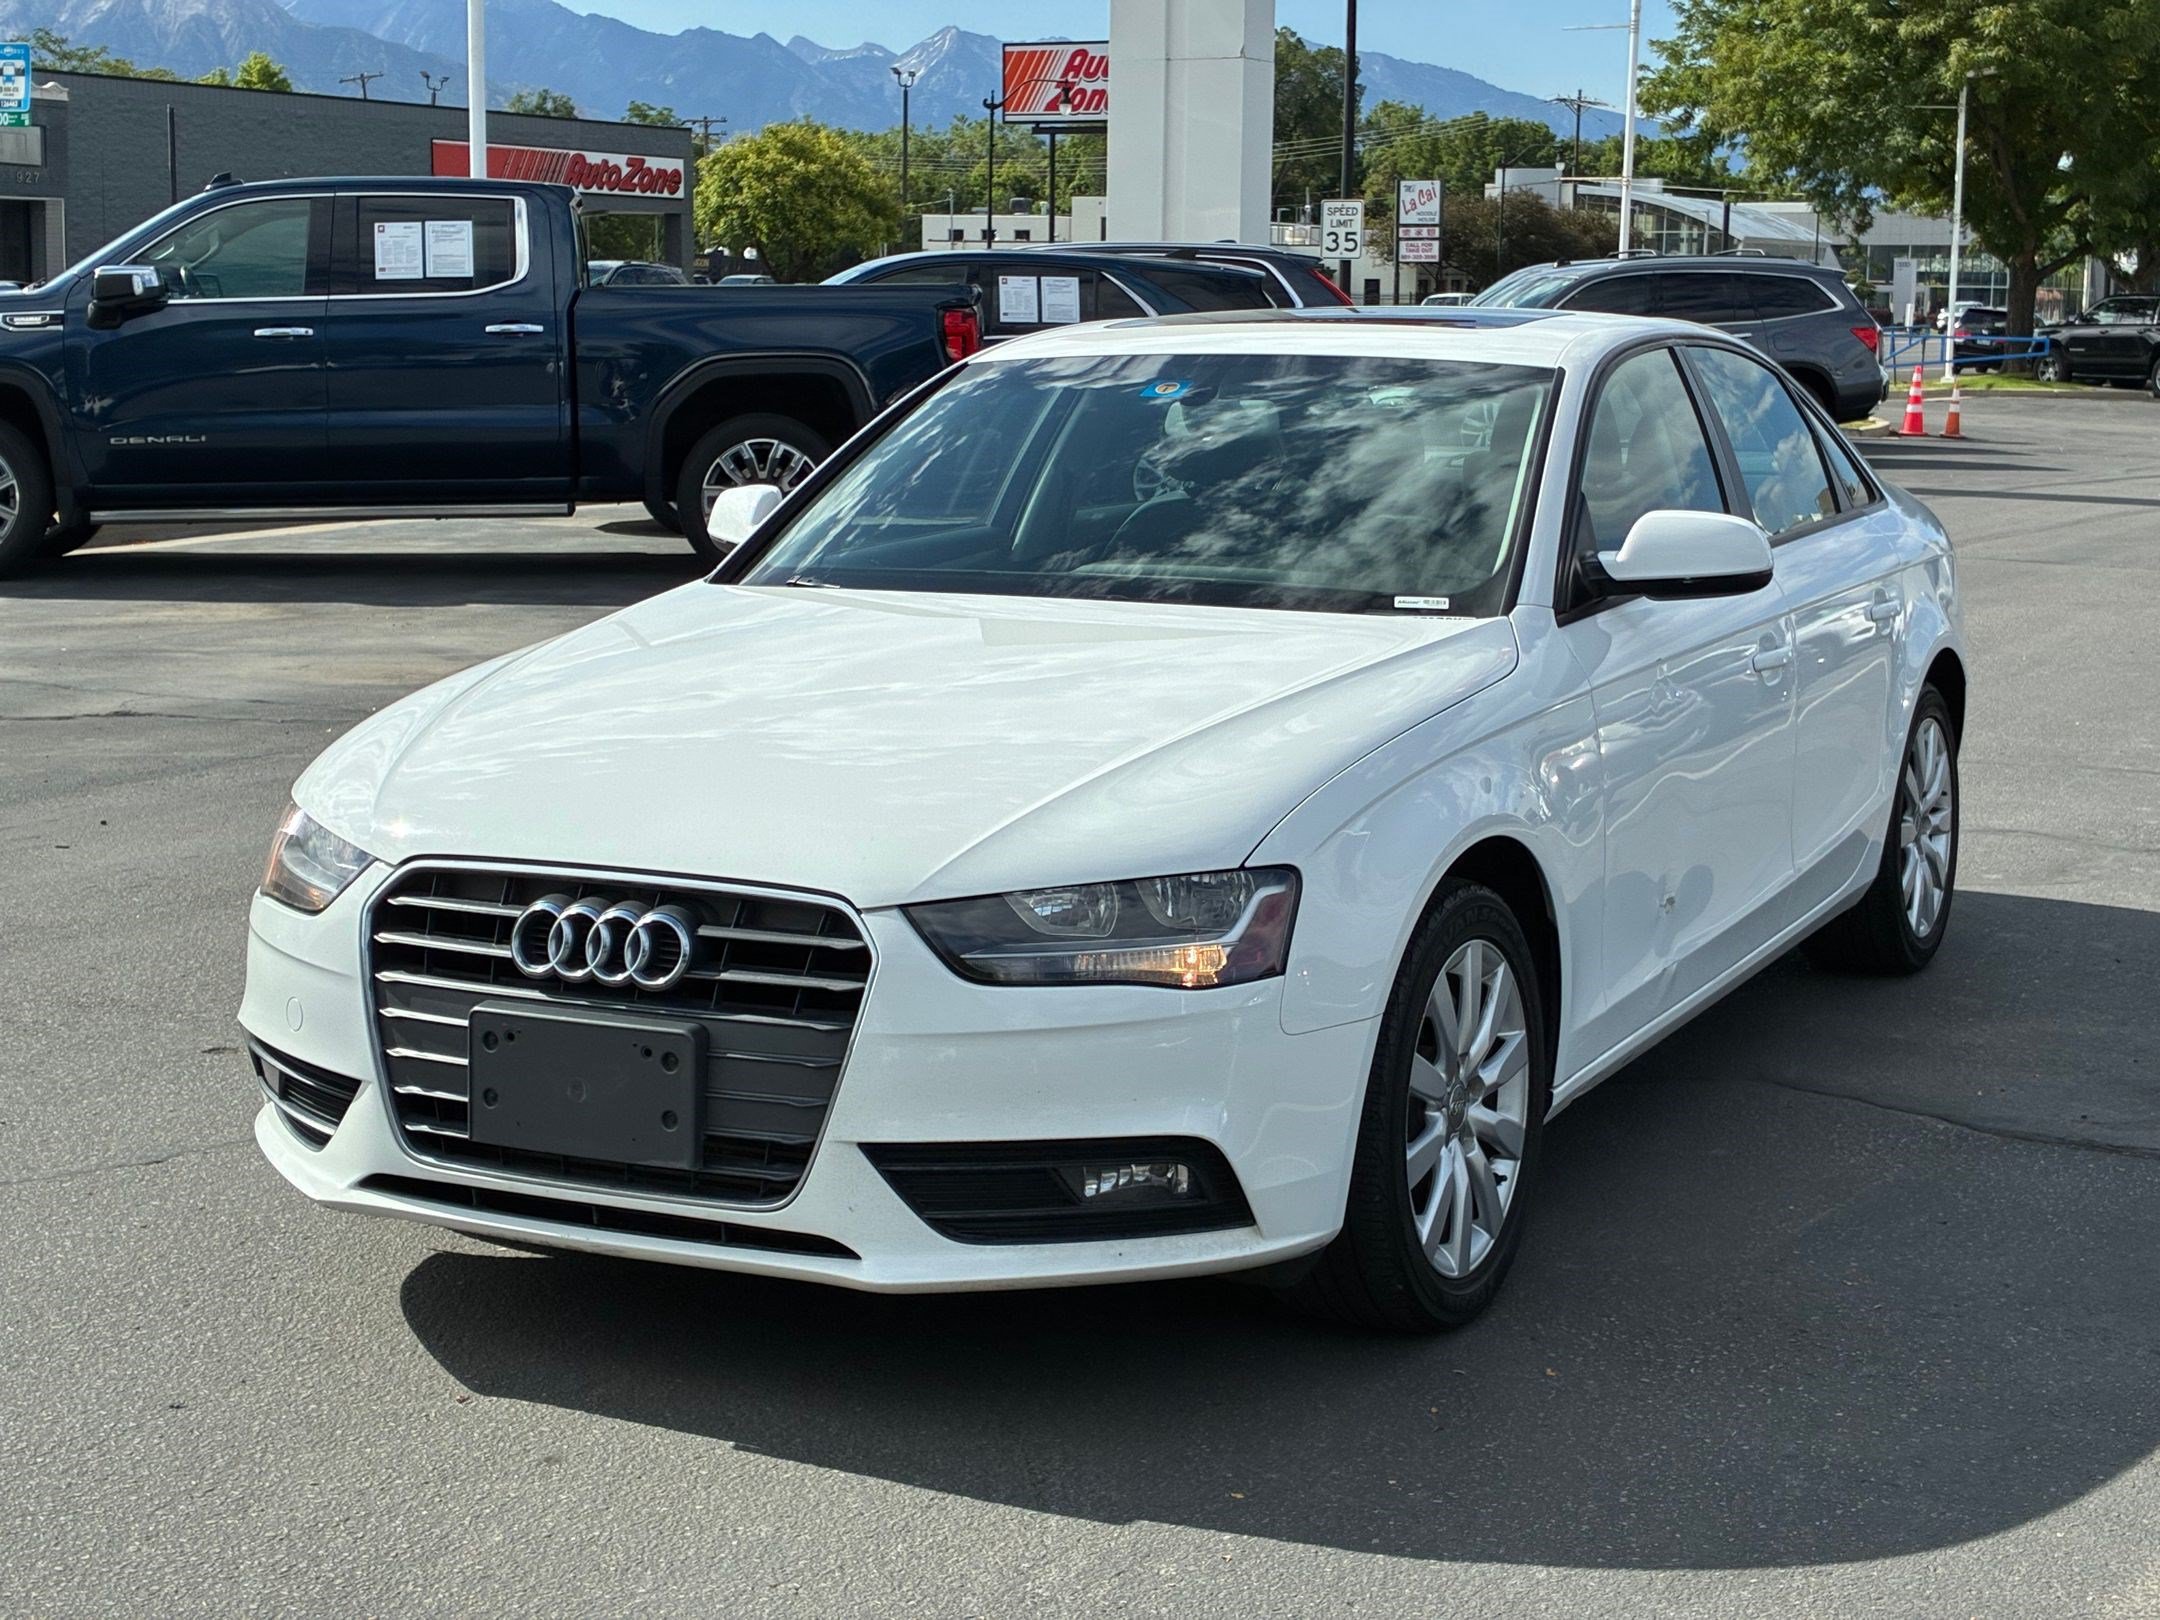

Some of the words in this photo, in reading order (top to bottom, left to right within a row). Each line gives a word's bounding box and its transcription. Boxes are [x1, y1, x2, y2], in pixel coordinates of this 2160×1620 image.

[1060, 48, 1109, 80] Au
[1044, 81, 1109, 114] Zon
[563, 153, 682, 195] AutoZone
[1327, 206, 1358, 216] SPEED
[1330, 218, 1354, 228] LIMIT
[1325, 231, 1358, 252] 35
[110, 435, 206, 445] DENALI
